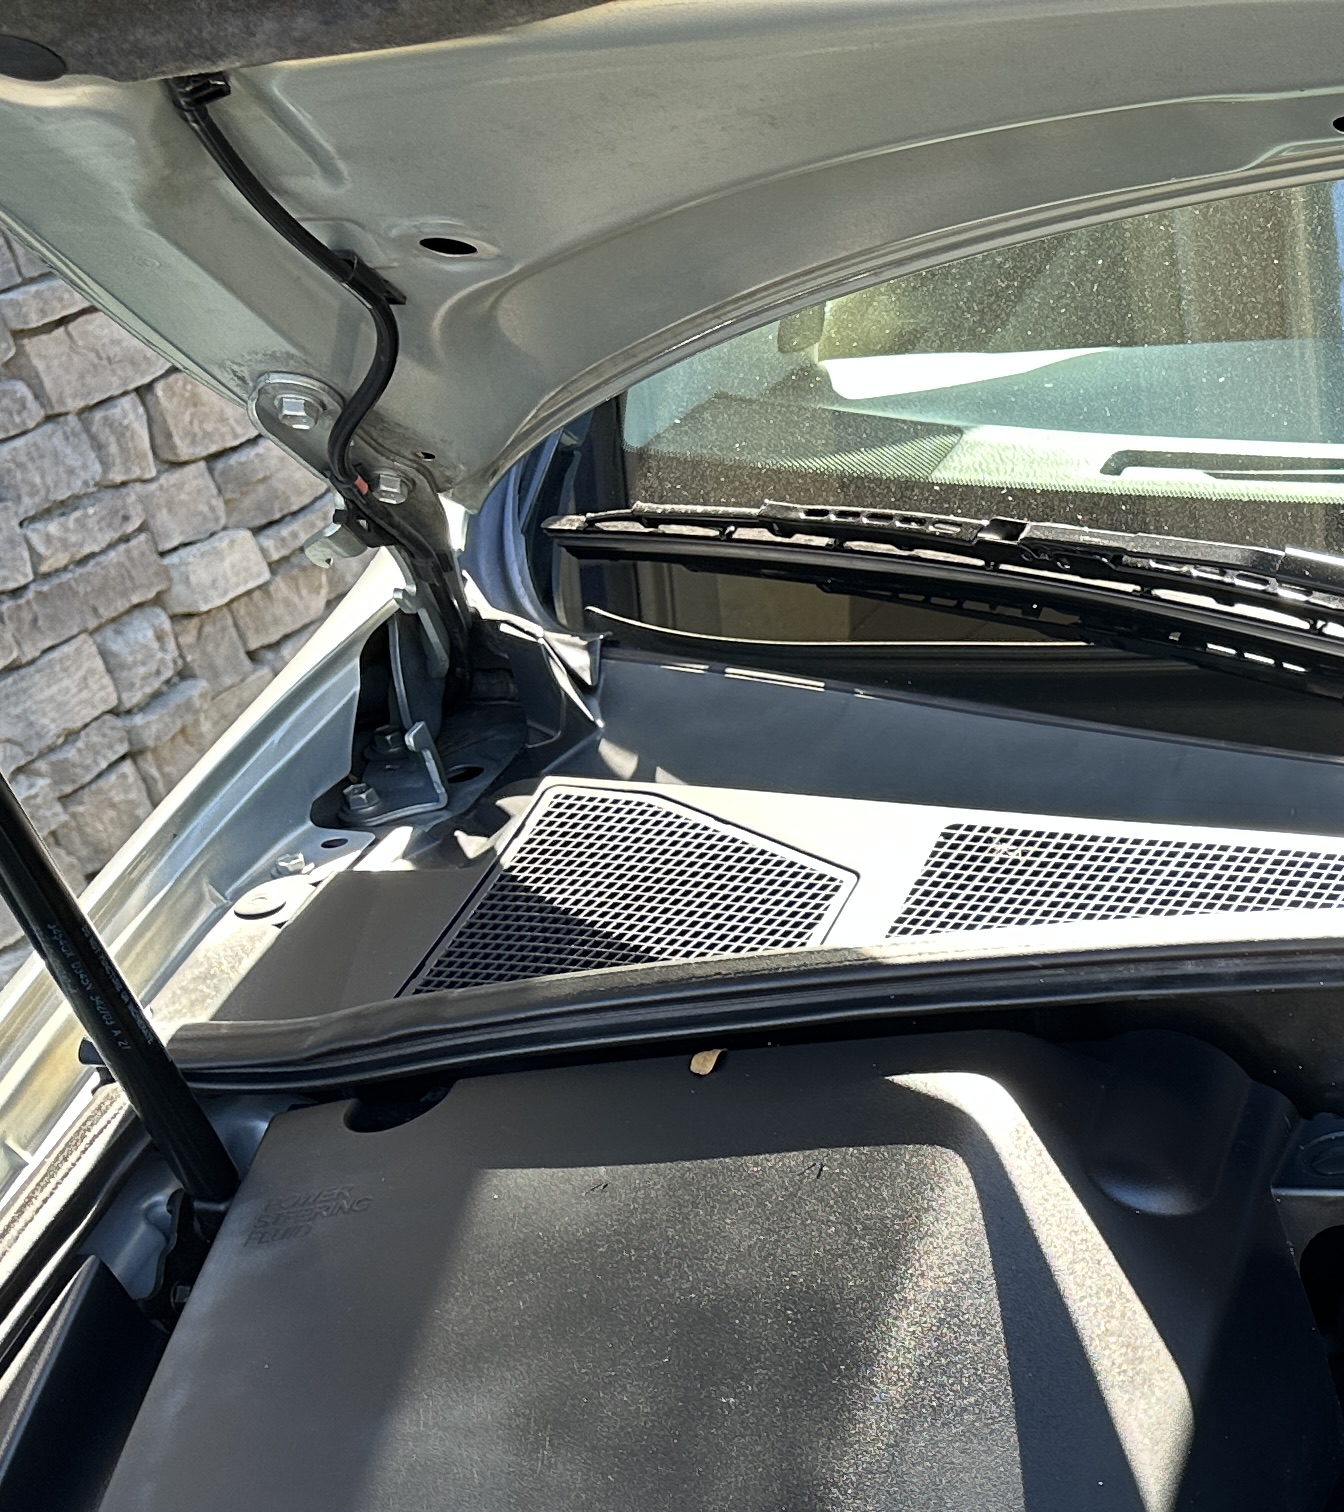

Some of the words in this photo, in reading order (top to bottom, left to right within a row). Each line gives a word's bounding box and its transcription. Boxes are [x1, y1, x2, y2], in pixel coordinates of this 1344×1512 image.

[264, 1184, 354, 1212] POWER
[254, 1196, 374, 1229] STEERING
[243, 1222, 313, 1248] FLUID
